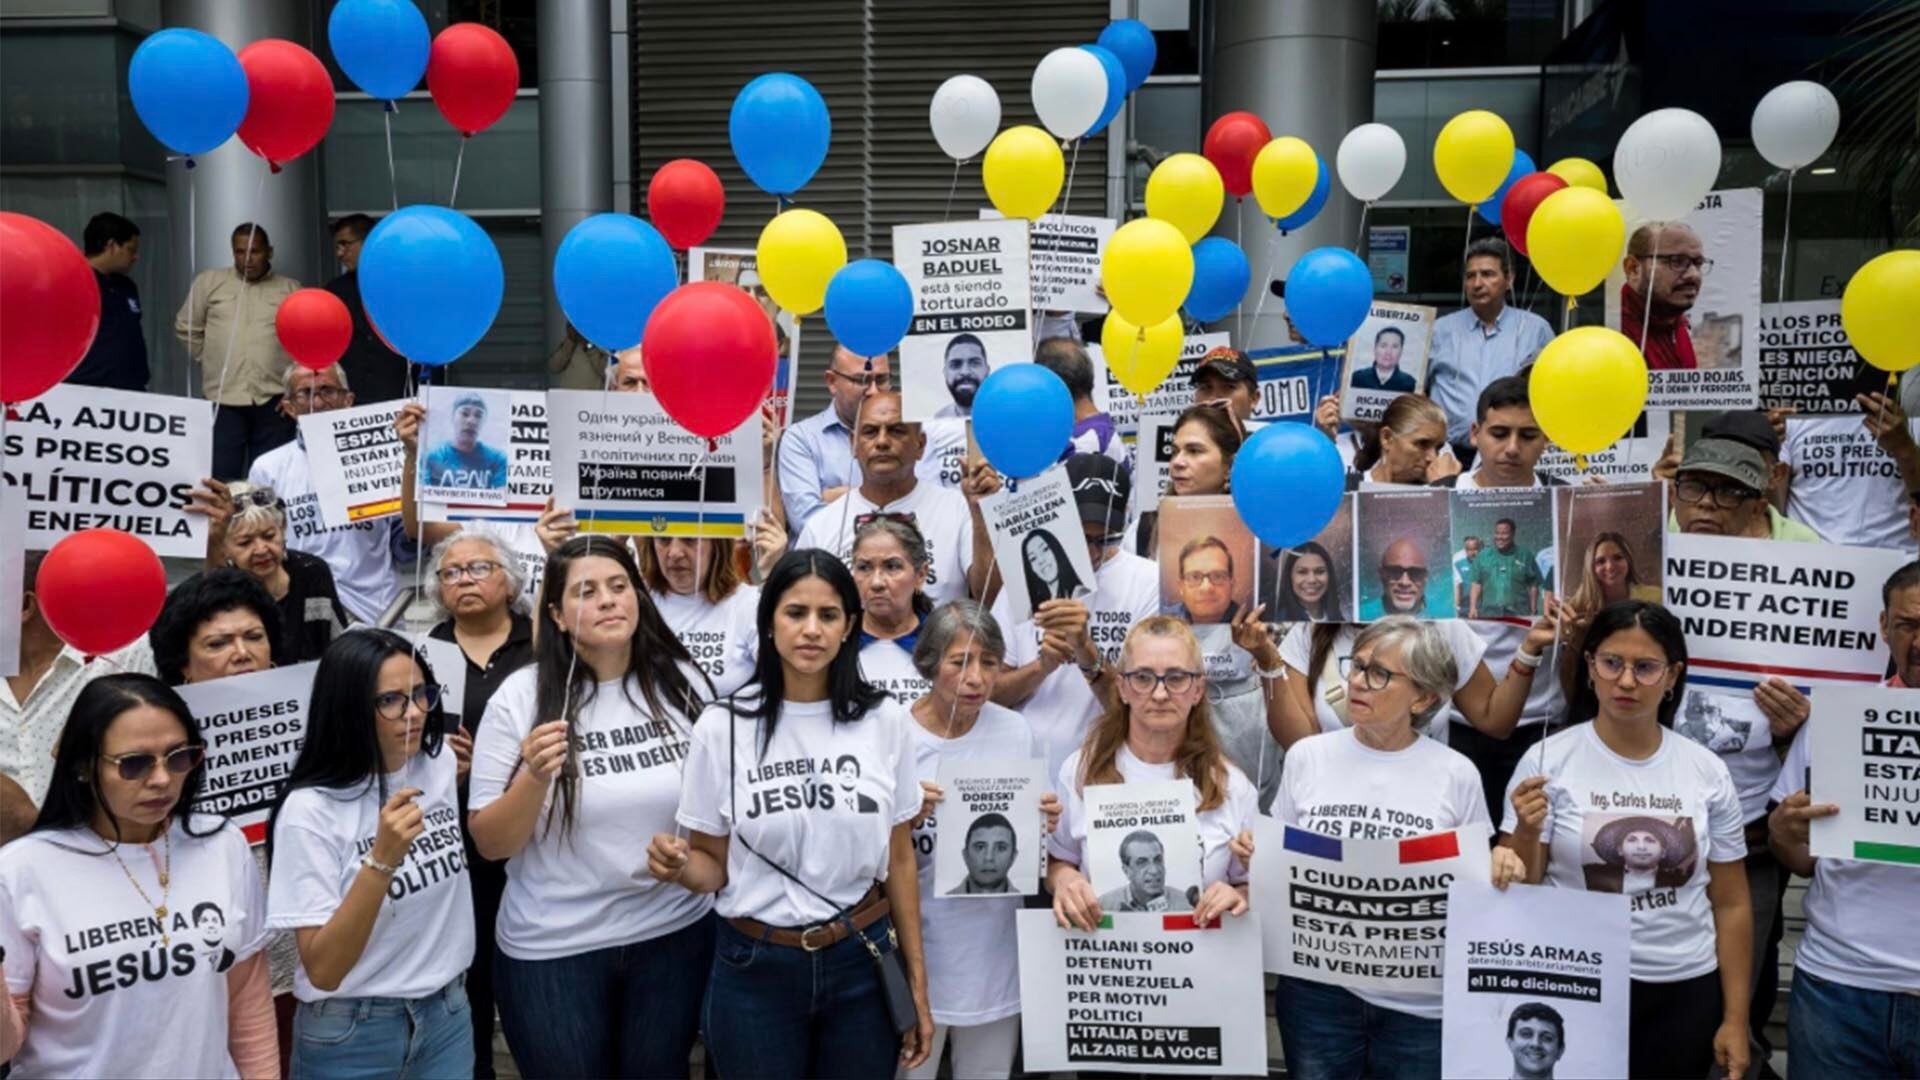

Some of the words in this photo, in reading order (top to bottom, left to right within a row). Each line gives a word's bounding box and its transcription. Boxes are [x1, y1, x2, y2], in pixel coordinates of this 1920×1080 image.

[922, 237, 1001, 254] JOSNAR
[923, 258, 1003, 276] BADUEL
[920, 279, 950, 294] está
[954, 277, 1002, 292] siendo
[920, 292, 1009, 312] torturado
[915, 319, 939, 332] EN
[940, 318, 958, 331] EL
[961, 315, 1016, 329] RODEO
[1370, 308, 1420, 322] LIBERTAD
[1772, 315, 1811, 330] LOS
[1816, 313, 1842, 328] PR
[1760, 351, 1789, 366] ES
[1793, 348, 1858, 364] NIEGA
[1665, 371, 1701, 384] JULIO
[1703, 370, 1744, 383] ROJAS
[1759, 362, 1854, 381] ATENCIÓN
[1700, 383, 1752, 393] PERIODISTA
[1759, 380, 1831, 397] MÉDICA
[1252, 379, 1308, 417] OMO
[18, 402, 62, 430] A,
[72, 406, 187, 437] AJUDE
[332, 420, 347, 431] 12
[578, 410, 618, 425] Один
[578, 430, 641, 445] язнений
[645, 433, 655, 447] у
[1803, 433, 1855, 446] LIBEREN
[1858, 433, 1866, 442] A
[35, 437, 170, 468] PRESOS
[340, 448, 390, 467] ESTÁN
[580, 449, 588, 460] з
[591, 449, 675, 464] політичних
[1591, 453, 1616, 463] LOS
[1802, 445, 1835, 460] LOS
[580, 464, 638, 482] Україна
[2, 467, 194, 510] LÍTICOS
[347, 481, 369, 494] EN
[581, 486, 665, 500] втрутитися
[289, 504, 315, 521] LOS
[995, 510, 1031, 531] MARÍA
[1033, 496, 1066, 516] ELENA
[1009, 511, 1060, 537] BECERRA
[1667, 557, 1855, 590] NEDERLAND
[1667, 586, 1751, 611] MOET
[1758, 594, 1849, 620] ACTIE
[1095, 610, 1132, 624] TODOS
[688, 631, 726, 643] TODOS
[1679, 616, 1876, 651] NDERNEMEN
[890, 679, 899, 690] A
[1864, 708, 1879, 723] 9
[214, 718, 302, 748] PRESOS
[573, 731, 609, 753] SER
[610, 719, 677, 747] BADUEL
[1864, 733, 1920, 755] ITA
[204, 737, 305, 770] TAMENTE
[582, 756, 607, 777] ES
[608, 753, 636, 774] UN
[747, 757, 815, 785] LIBEREN
[820, 757, 834, 775] A
[745, 778, 835, 819] JESÚS
[962, 792, 1015, 802] DORESKI
[1612, 791, 1647, 809] Carlos
[1864, 784, 1920, 804] INJU
[970, 802, 1009, 812] ROJAS
[1864, 807, 1898, 824] EN
[1093, 817, 1138, 829] BIAGIO
[1141, 814, 1185, 826] PILIERI
[1310, 803, 1368, 819] LIBEREN
[1371, 807, 1382, 821] A
[1386, 809, 1435, 831] TODOS
[1290, 866, 1298, 880] 1
[1293, 889, 1448, 917] FRANCÉS
[64, 916, 164, 955] LIBEREN
[172, 911, 189, 932] A
[1292, 913, 1357, 938] ESTÁ
[1065, 938, 1138, 953] ITALIANI
[1142, 941, 1194, 954] SONO
[1292, 931, 1444, 960] INJUSTAMENT
[1467, 938, 1525, 957] JESÚS
[1529, 945, 1603, 966] ARMAS
[63, 940, 196, 1000] JESÚS
[1066, 956, 1152, 971] DETENUTI
[1293, 950, 1320, 969] EN
[1325, 957, 1443, 979] VENEZUEL
[1468, 956, 1514, 967] detenido
[1515, 958, 1602, 975] arbitrariamente
[1066, 973, 1084, 986] IN
[1089, 975, 1194, 990] VENEZUELA
[1470, 975, 1483, 988] el
[1486, 975, 1498, 988] 11
[1500, 975, 1519, 989] de
[1521, 976, 1599, 997] diciembre
[1067, 991, 1101, 1004] PER
[1105, 992, 1168, 1006] MOTIVI
[1068, 1008, 1143, 1022] POLITICI
[1069, 1025, 1138, 1040] L'ITALIA
[1141, 1028, 1189, 1042] DEVE
[1069, 1043, 1139, 1058] ALZARE
[1141, 1045, 1166, 1059] LA
[1167, 1046, 1219, 1061] VOCE
